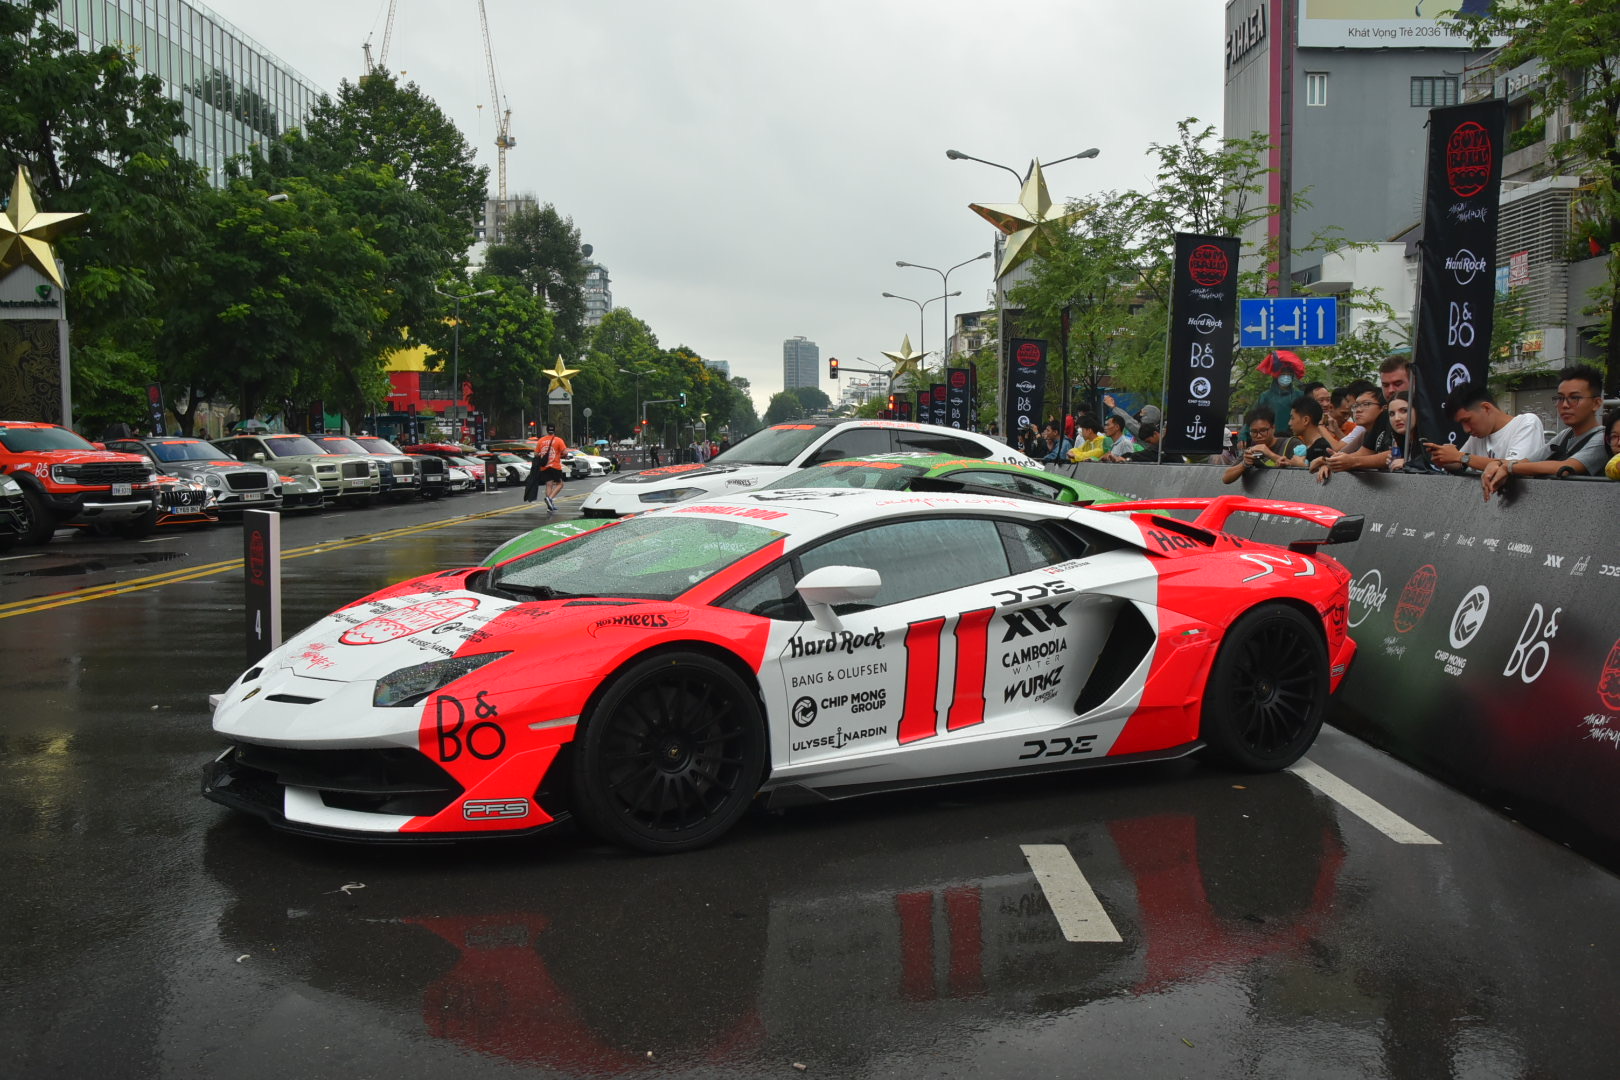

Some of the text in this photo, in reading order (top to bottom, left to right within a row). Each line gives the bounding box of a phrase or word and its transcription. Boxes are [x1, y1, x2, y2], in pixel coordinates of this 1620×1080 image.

[1225, 4, 1266, 70] FAHASA
[1348, 27, 1370, 37] Khát
[1372, 27, 1396, 39] Vọng
[1415, 26, 1441, 37] 2036
[1445, 257, 1487, 273] Hard Rock
[1188, 317, 1223, 329] Hard Rock
[255, 609, 262, 640] 4
[612, 614, 669, 627] WHEELS
[788, 631, 838, 658] Hard
[1002, 637, 1067, 668] CAMBODIA
[792, 662, 888, 688] BANG & OLUFSEN
[1012, 654, 1060, 675] WATER
[1443, 664, 1463, 677] GROUP
[1004, 665, 1065, 704] WURKZ
[821, 688, 886, 709] CHIP MONG
[851, 700, 886, 714] GROUP
[792, 726, 887, 752] ULYSSE NARDIN
[464, 801, 528, 817] PFS
